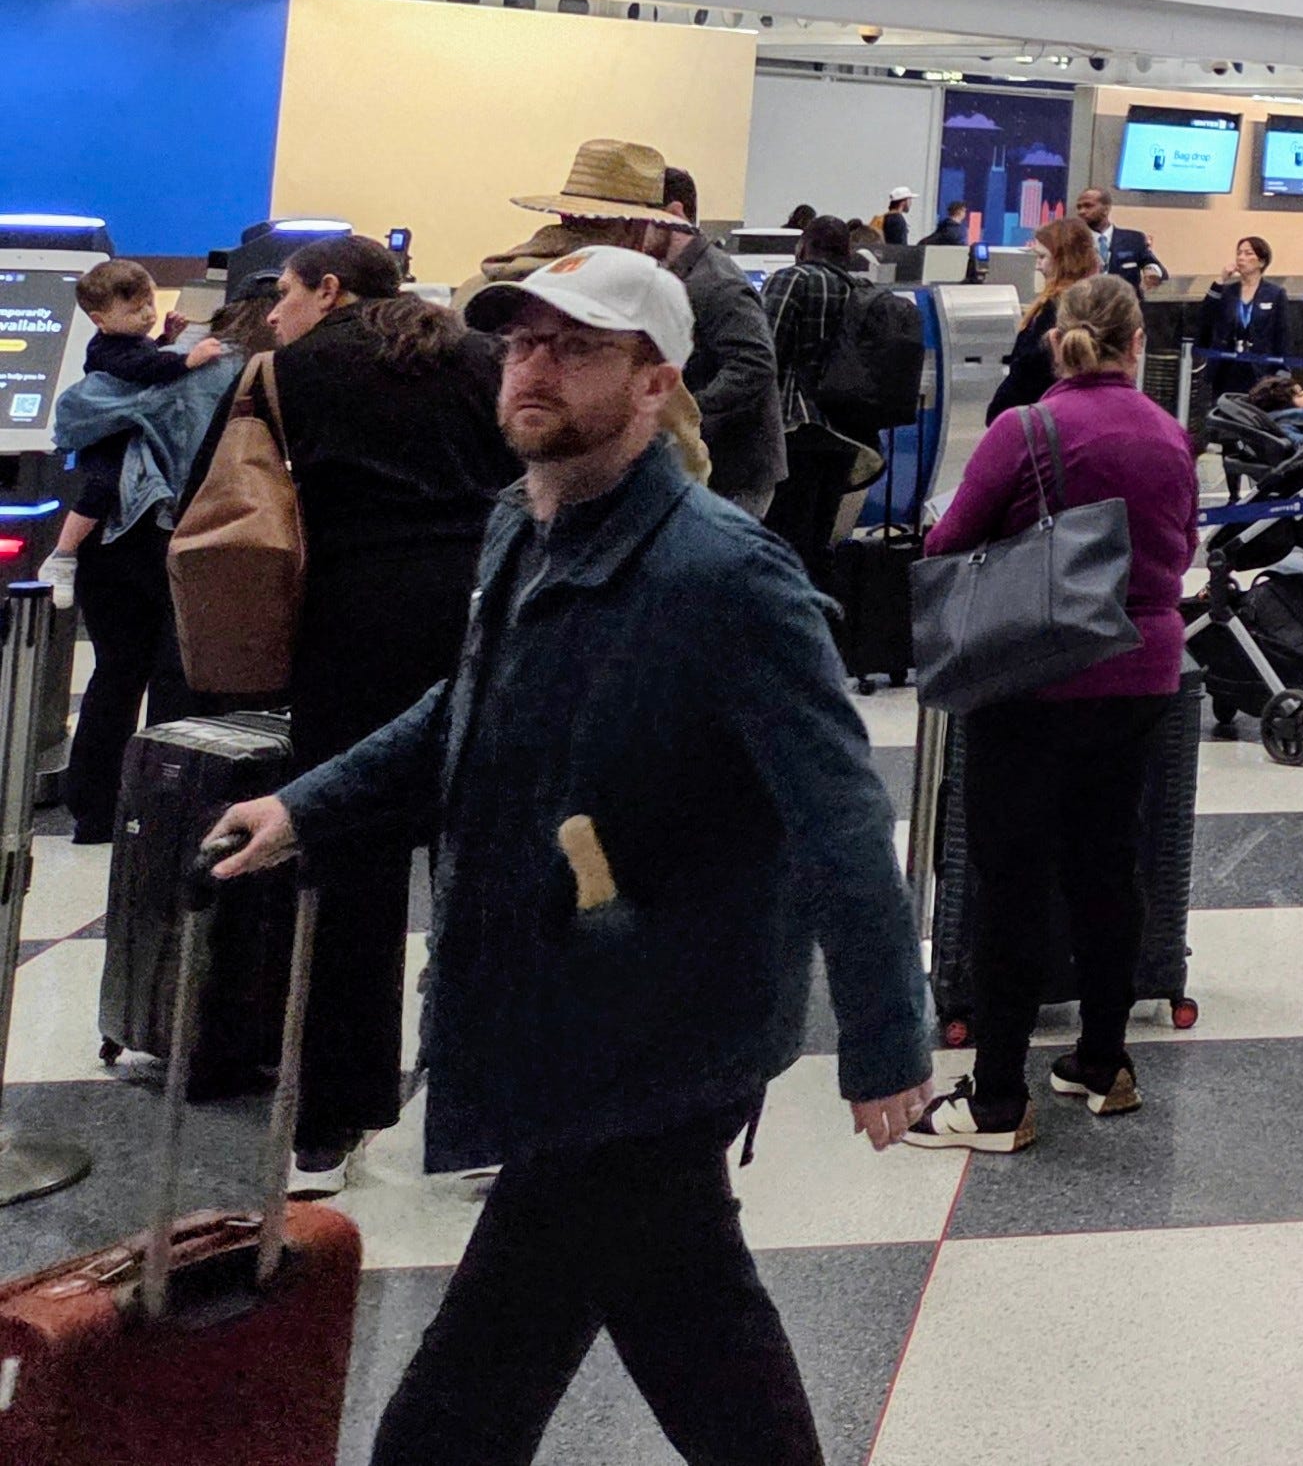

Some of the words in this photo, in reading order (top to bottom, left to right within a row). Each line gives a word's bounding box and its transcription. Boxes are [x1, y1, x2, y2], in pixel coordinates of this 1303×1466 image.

[1174, 150, 1190, 162] Bag
[1192, 151, 1211, 162] drop
[0, 308, 52, 319] mporarily
[0, 319, 62, 332] vailable
